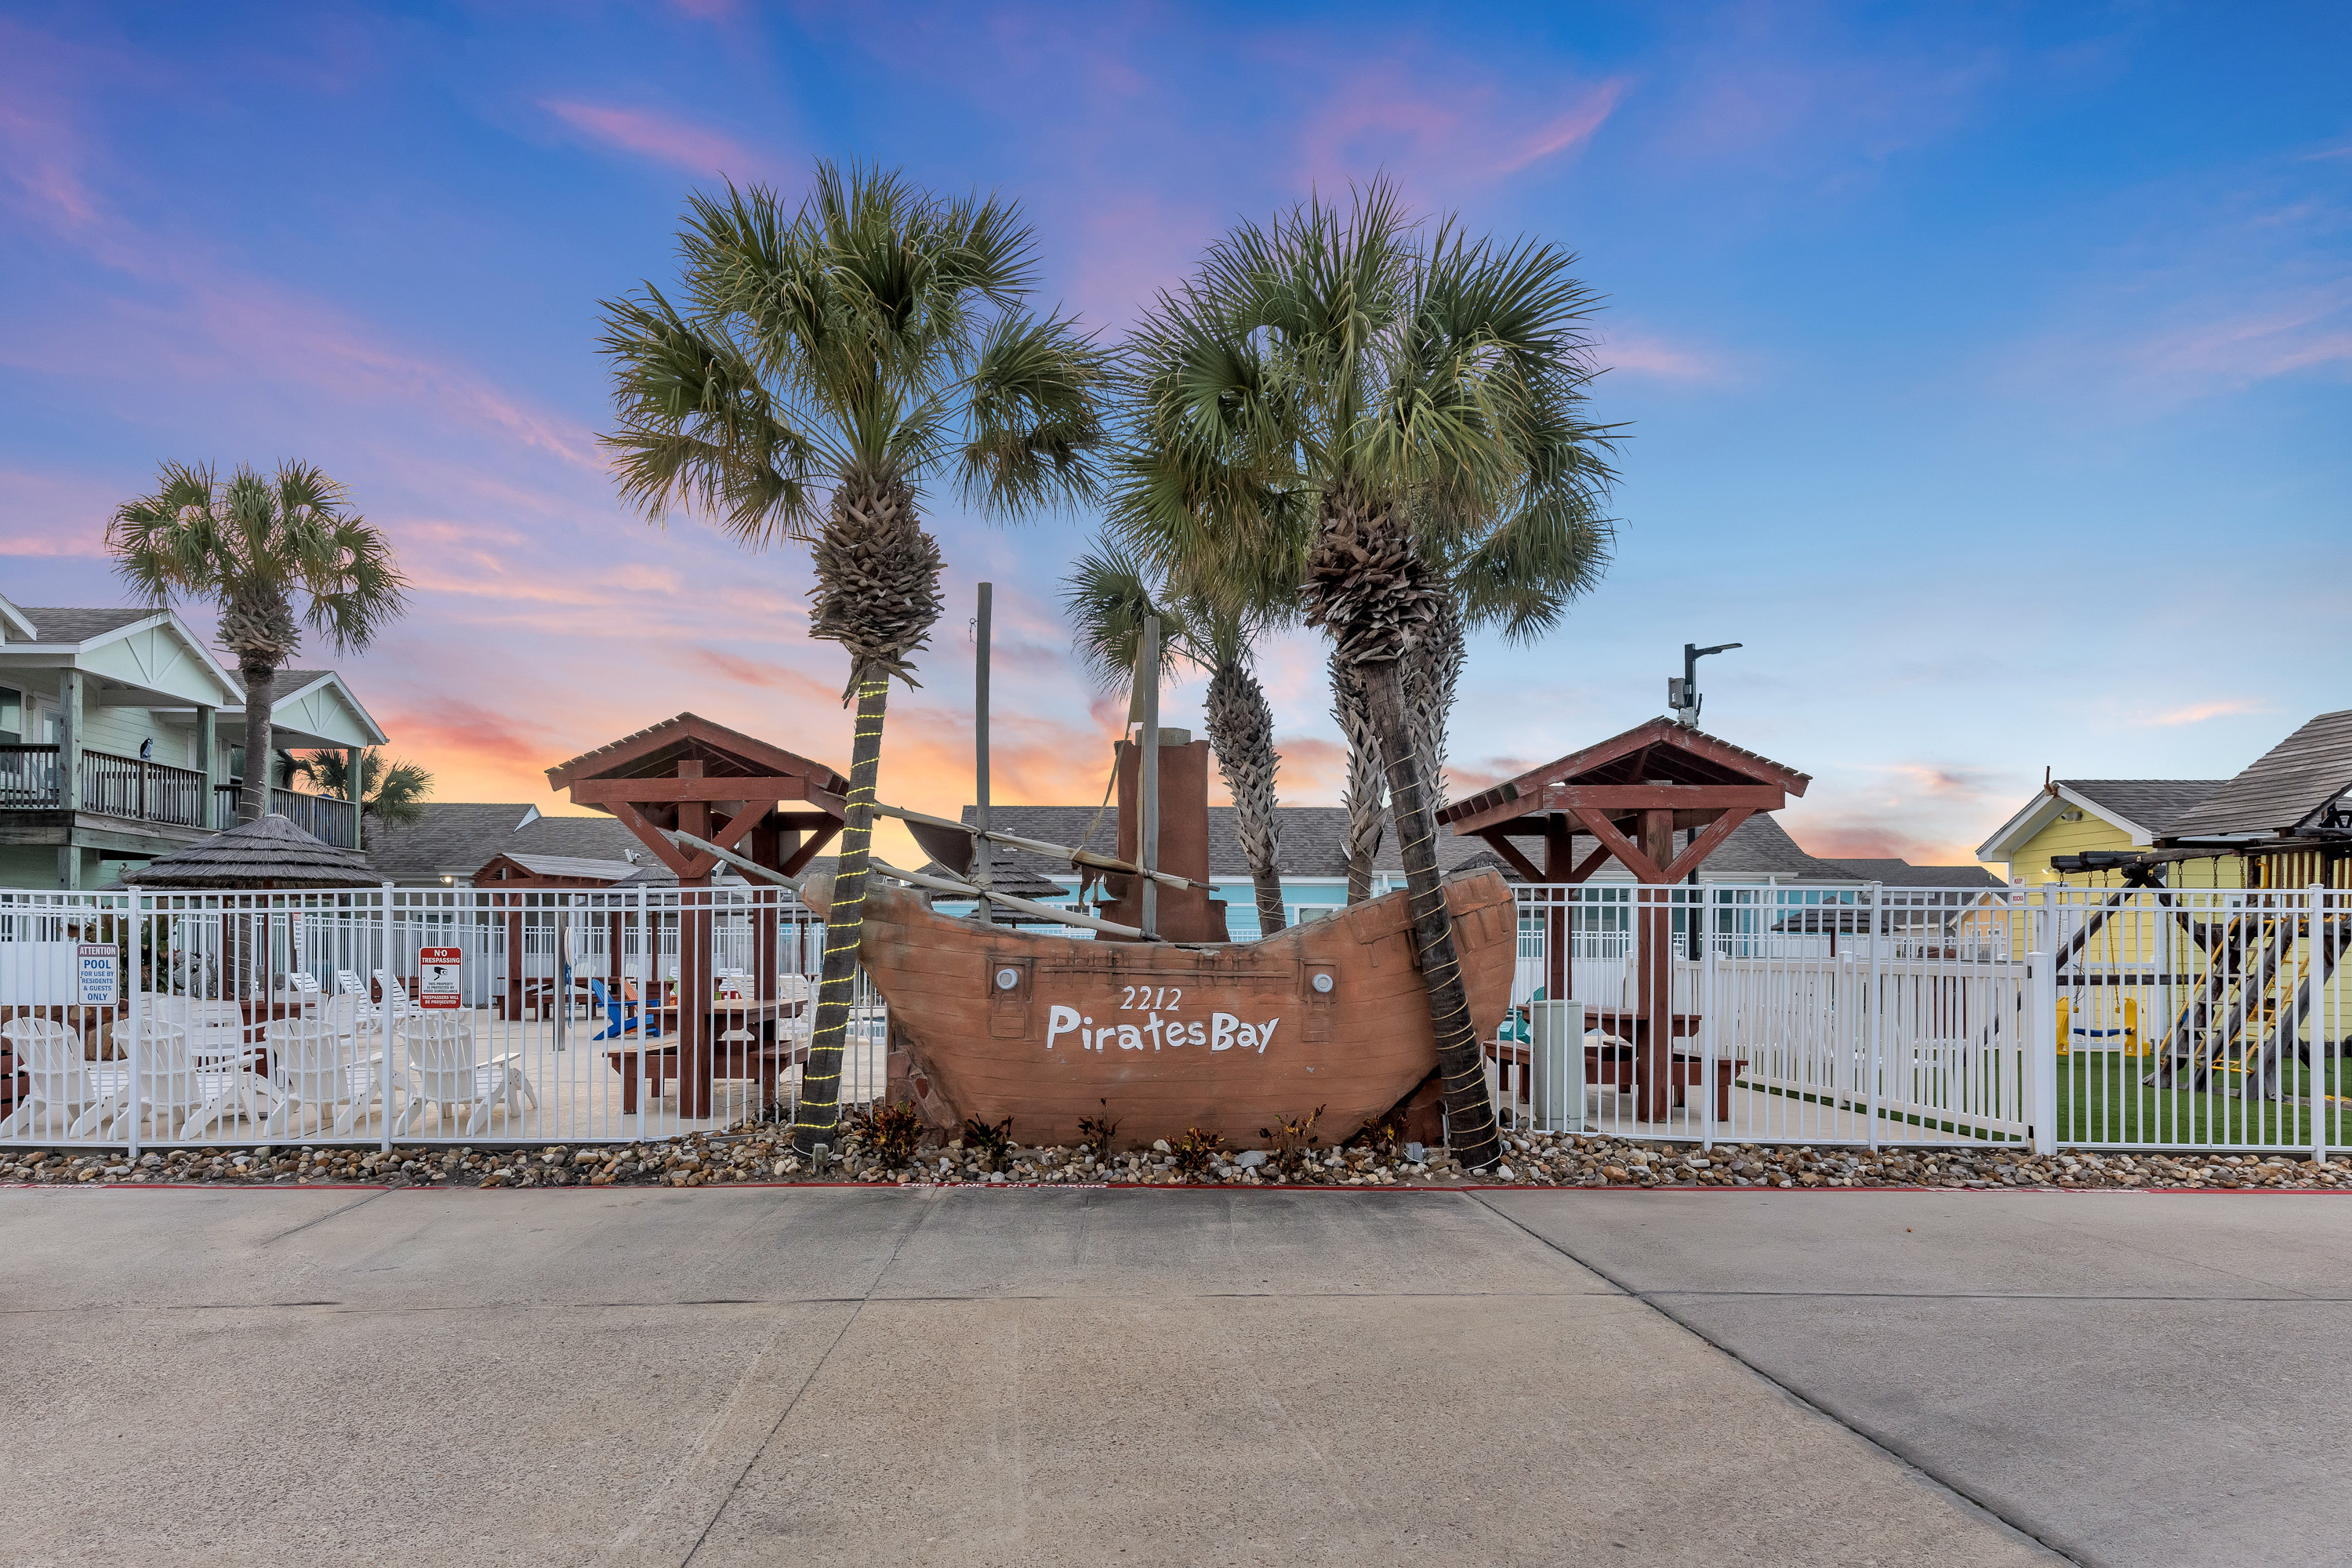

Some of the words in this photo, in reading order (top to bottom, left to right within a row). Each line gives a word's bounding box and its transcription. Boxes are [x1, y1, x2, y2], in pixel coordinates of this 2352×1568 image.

[79, 946, 116, 955] ATTENTION
[84, 960, 111, 969] POOL
[1120, 985, 1182, 1011] 2212
